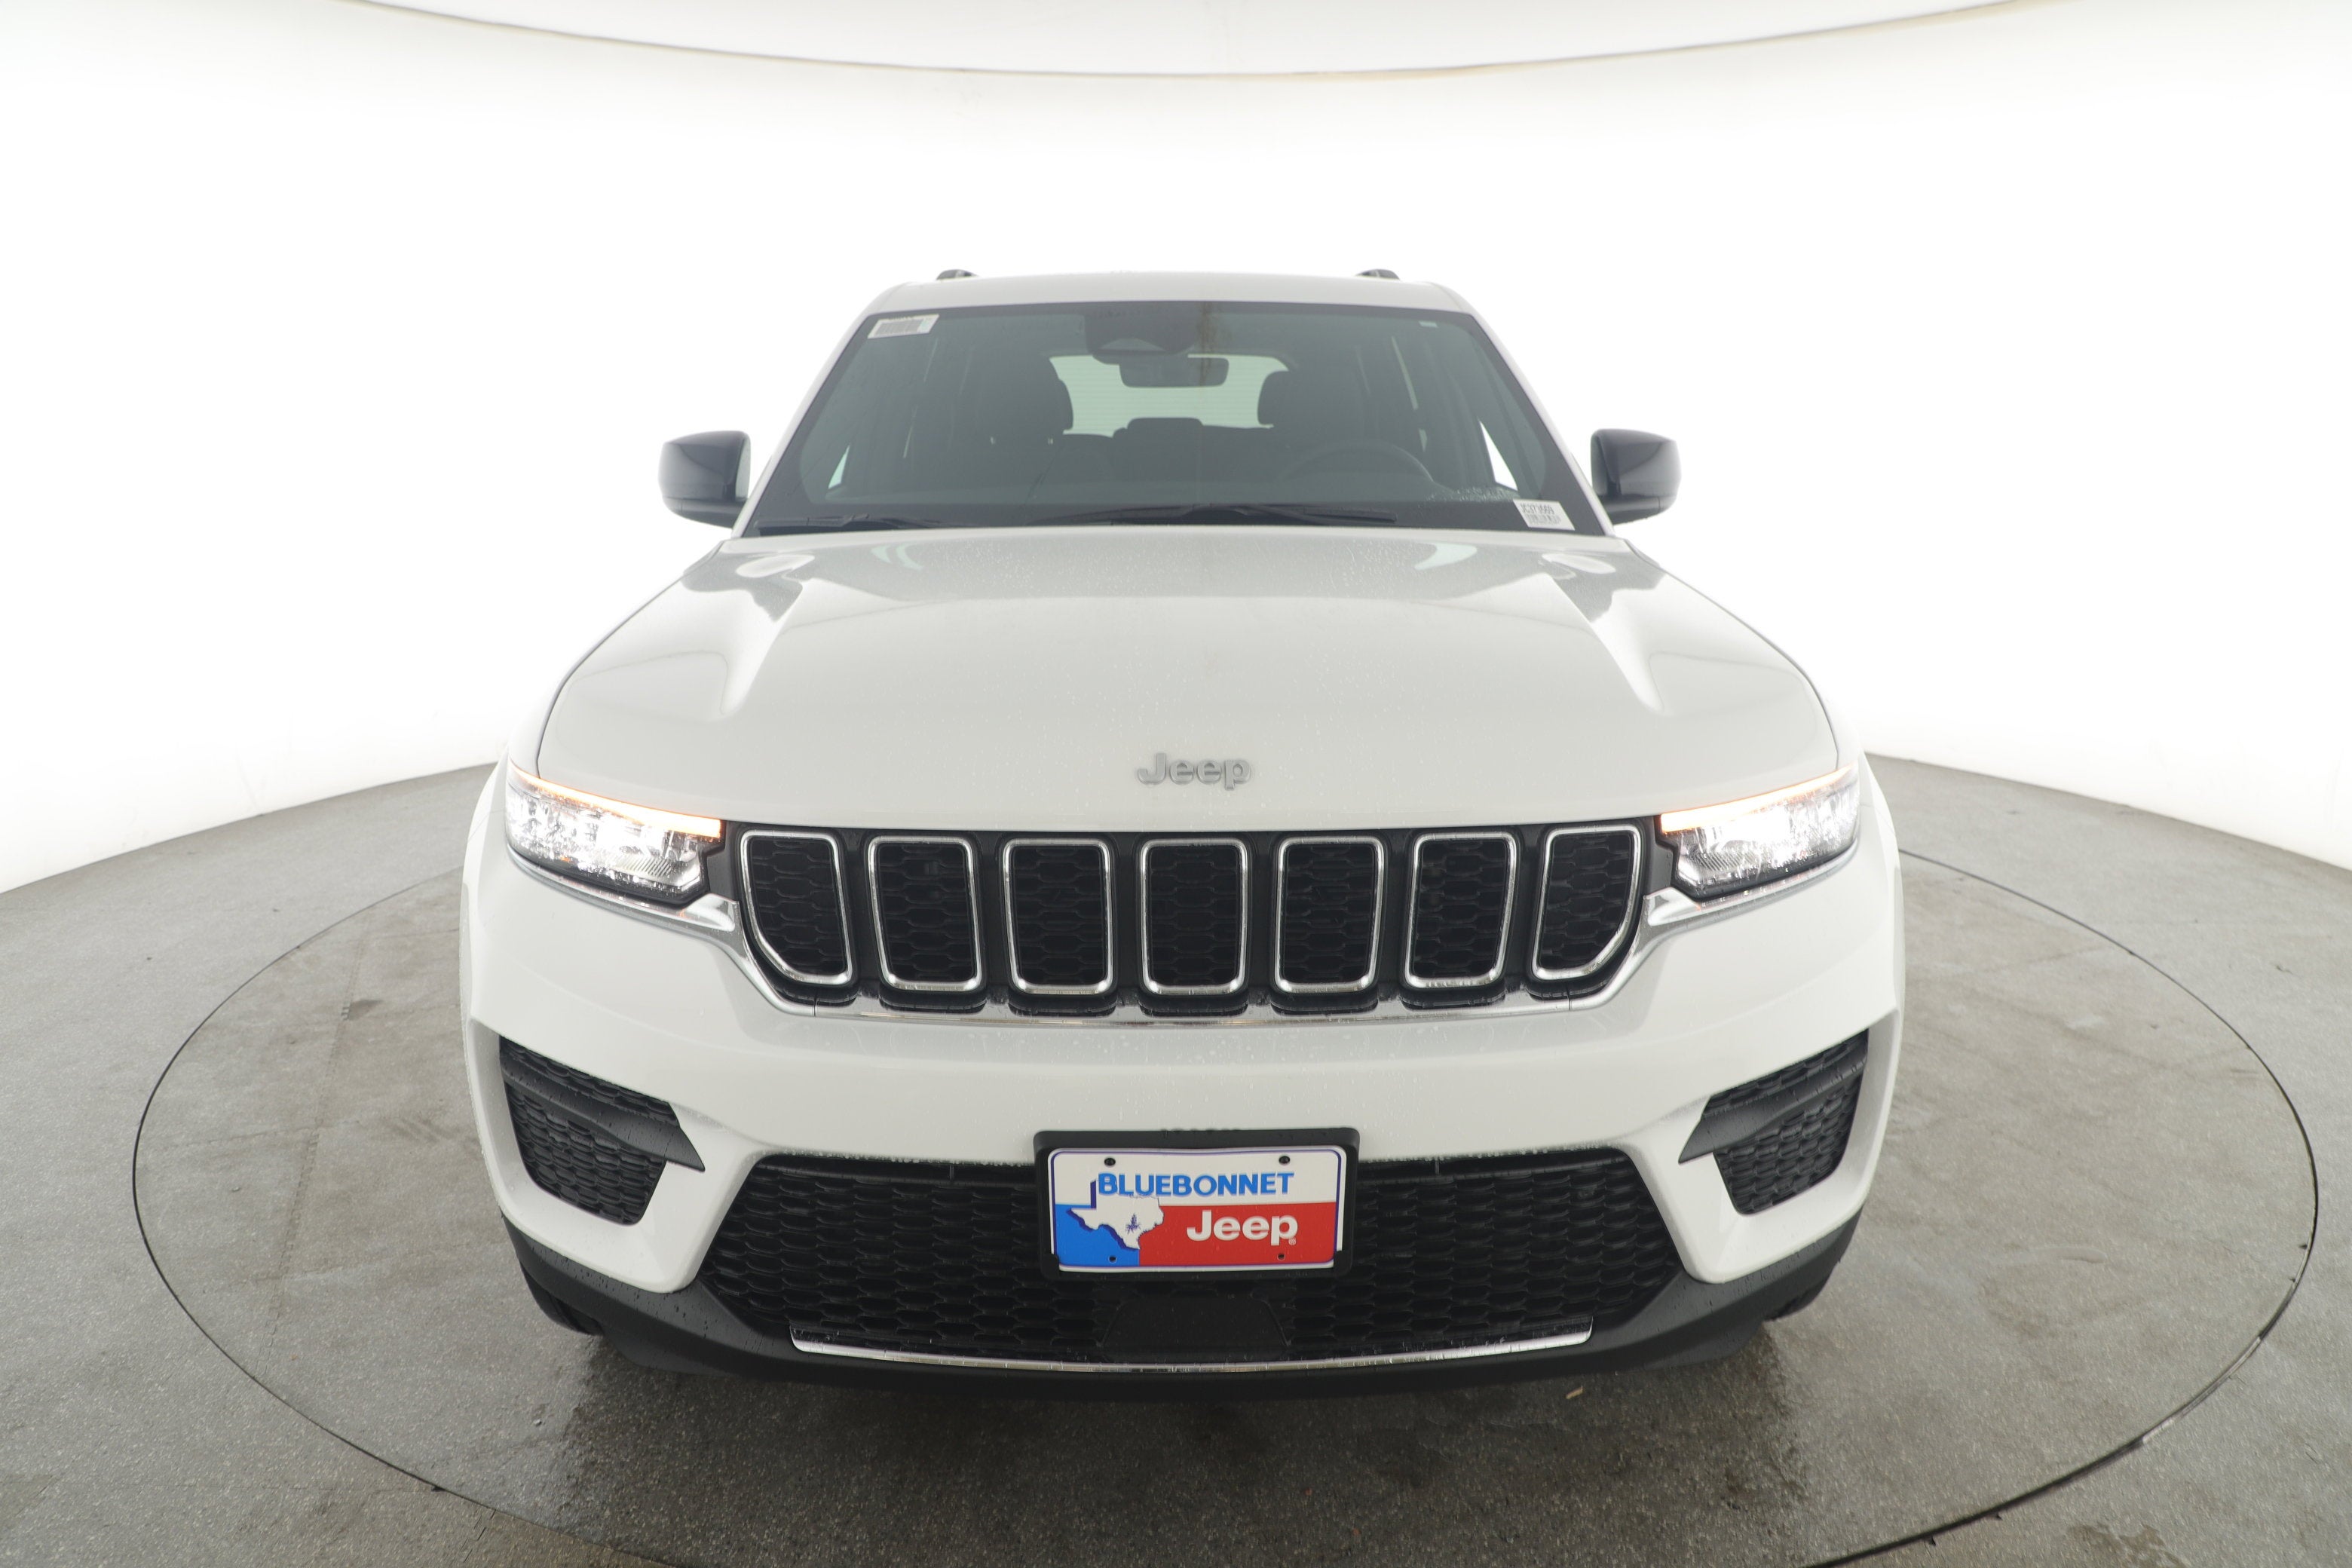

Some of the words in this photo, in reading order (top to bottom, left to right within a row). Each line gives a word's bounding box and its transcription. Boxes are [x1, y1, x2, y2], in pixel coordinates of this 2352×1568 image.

[1137, 752, 1251, 791] Jeep
[1098, 1172, 1295, 1196] BLUEBONNET
[1187, 1210, 1298, 1246] Jeep
